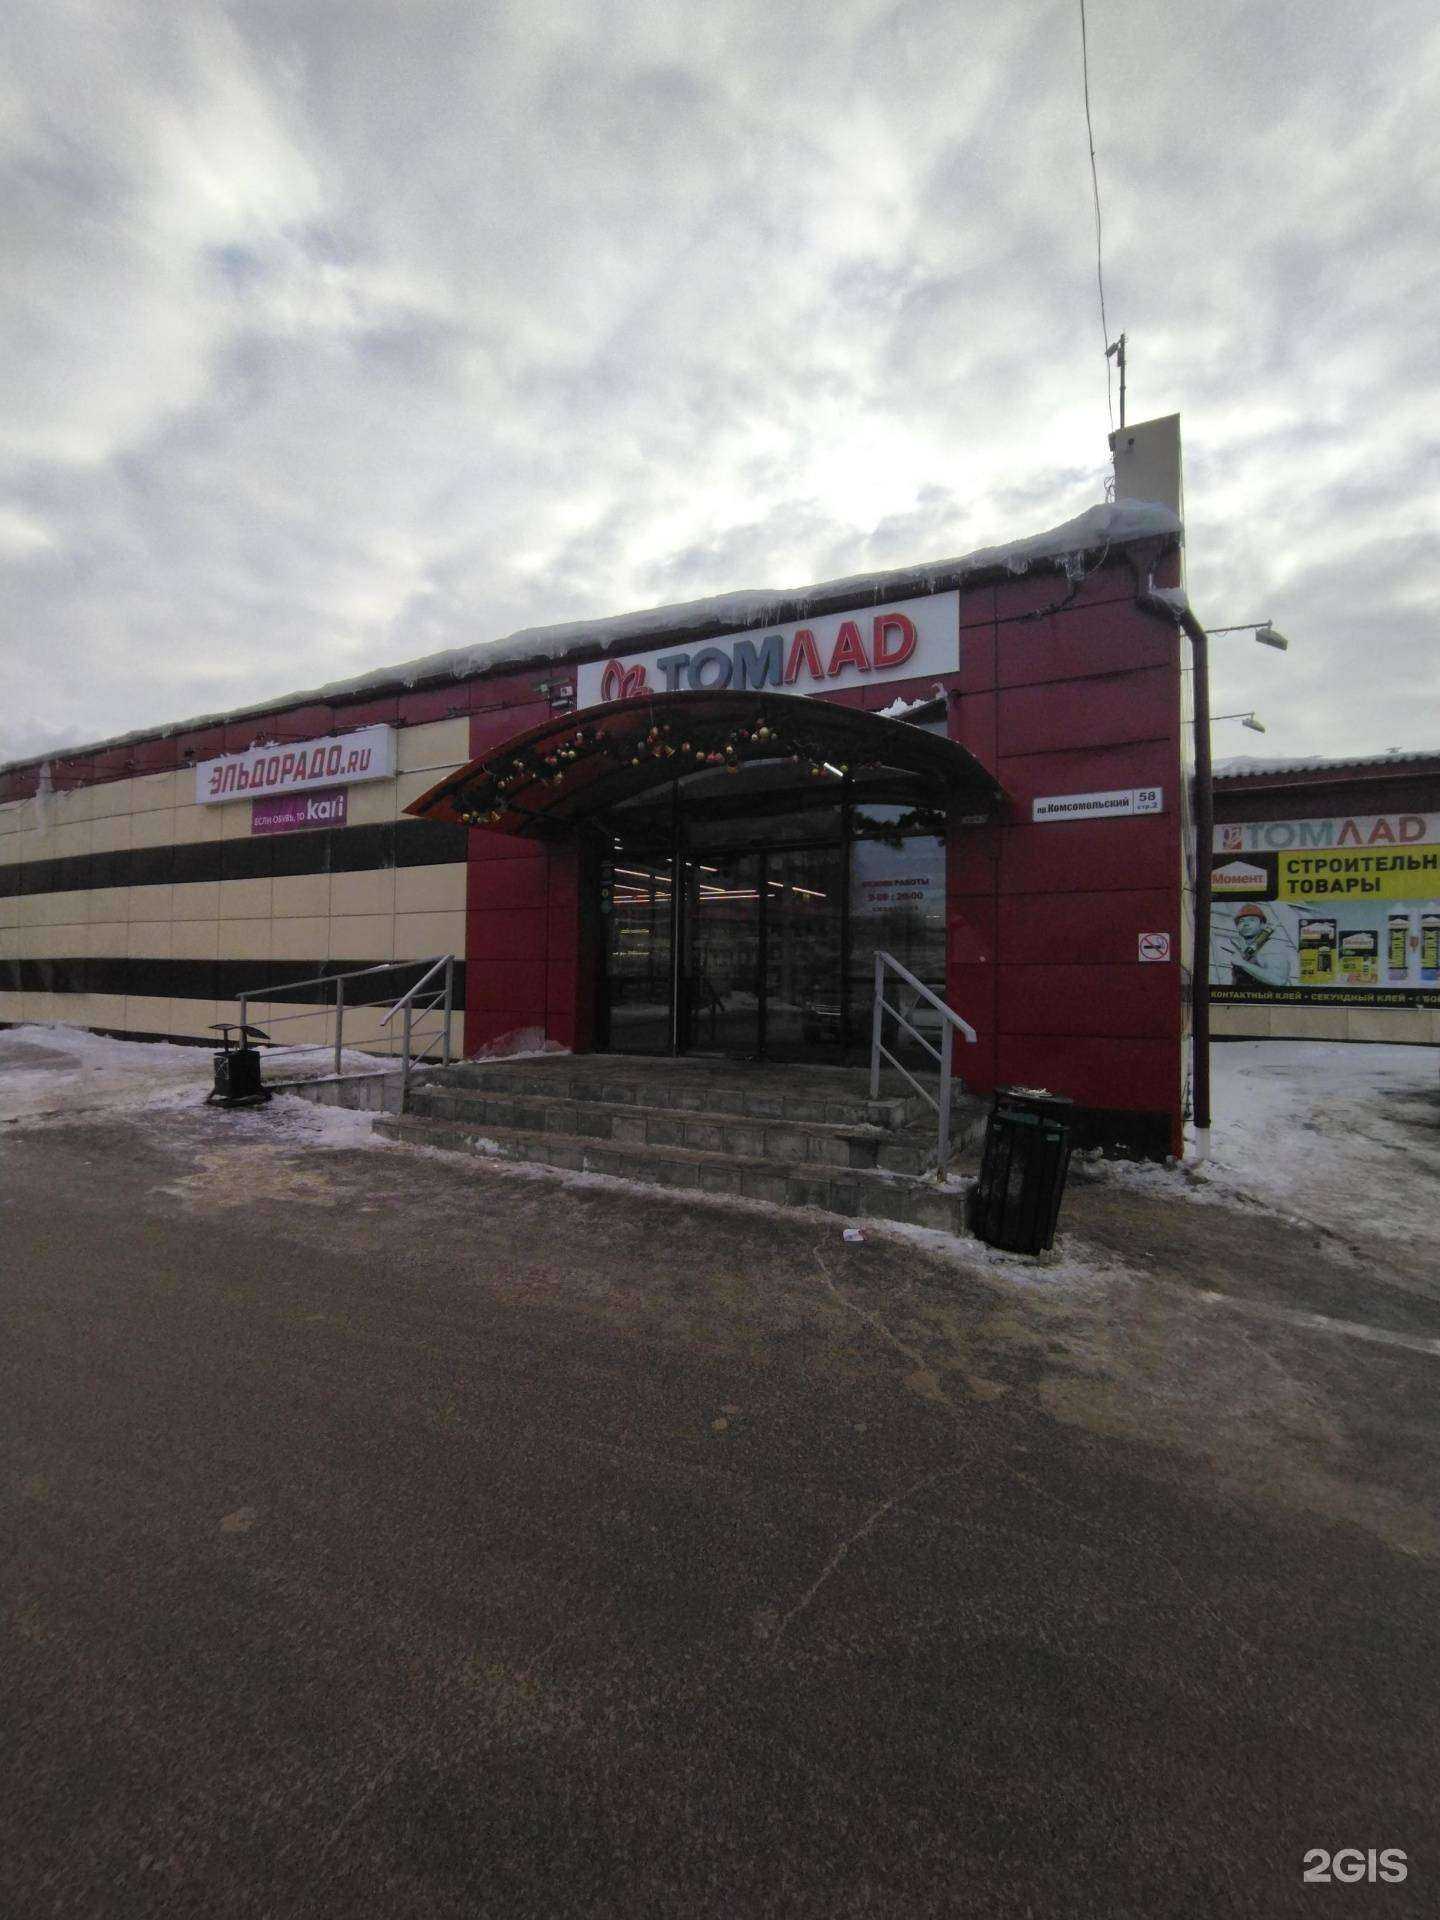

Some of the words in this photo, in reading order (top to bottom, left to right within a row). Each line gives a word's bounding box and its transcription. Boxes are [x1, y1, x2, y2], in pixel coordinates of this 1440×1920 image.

[208, 745, 372, 794] ЭЛЬДОРАДО.RU
[1139, 792, 1156, 802] 58
[306, 795, 344, 820] kari
[1210, 872, 1265, 884] Момент
[1287, 877, 1381, 894] ТОВАРЫ
[1210, 990, 1273, 1000] КОНТАКТНЫЙ
